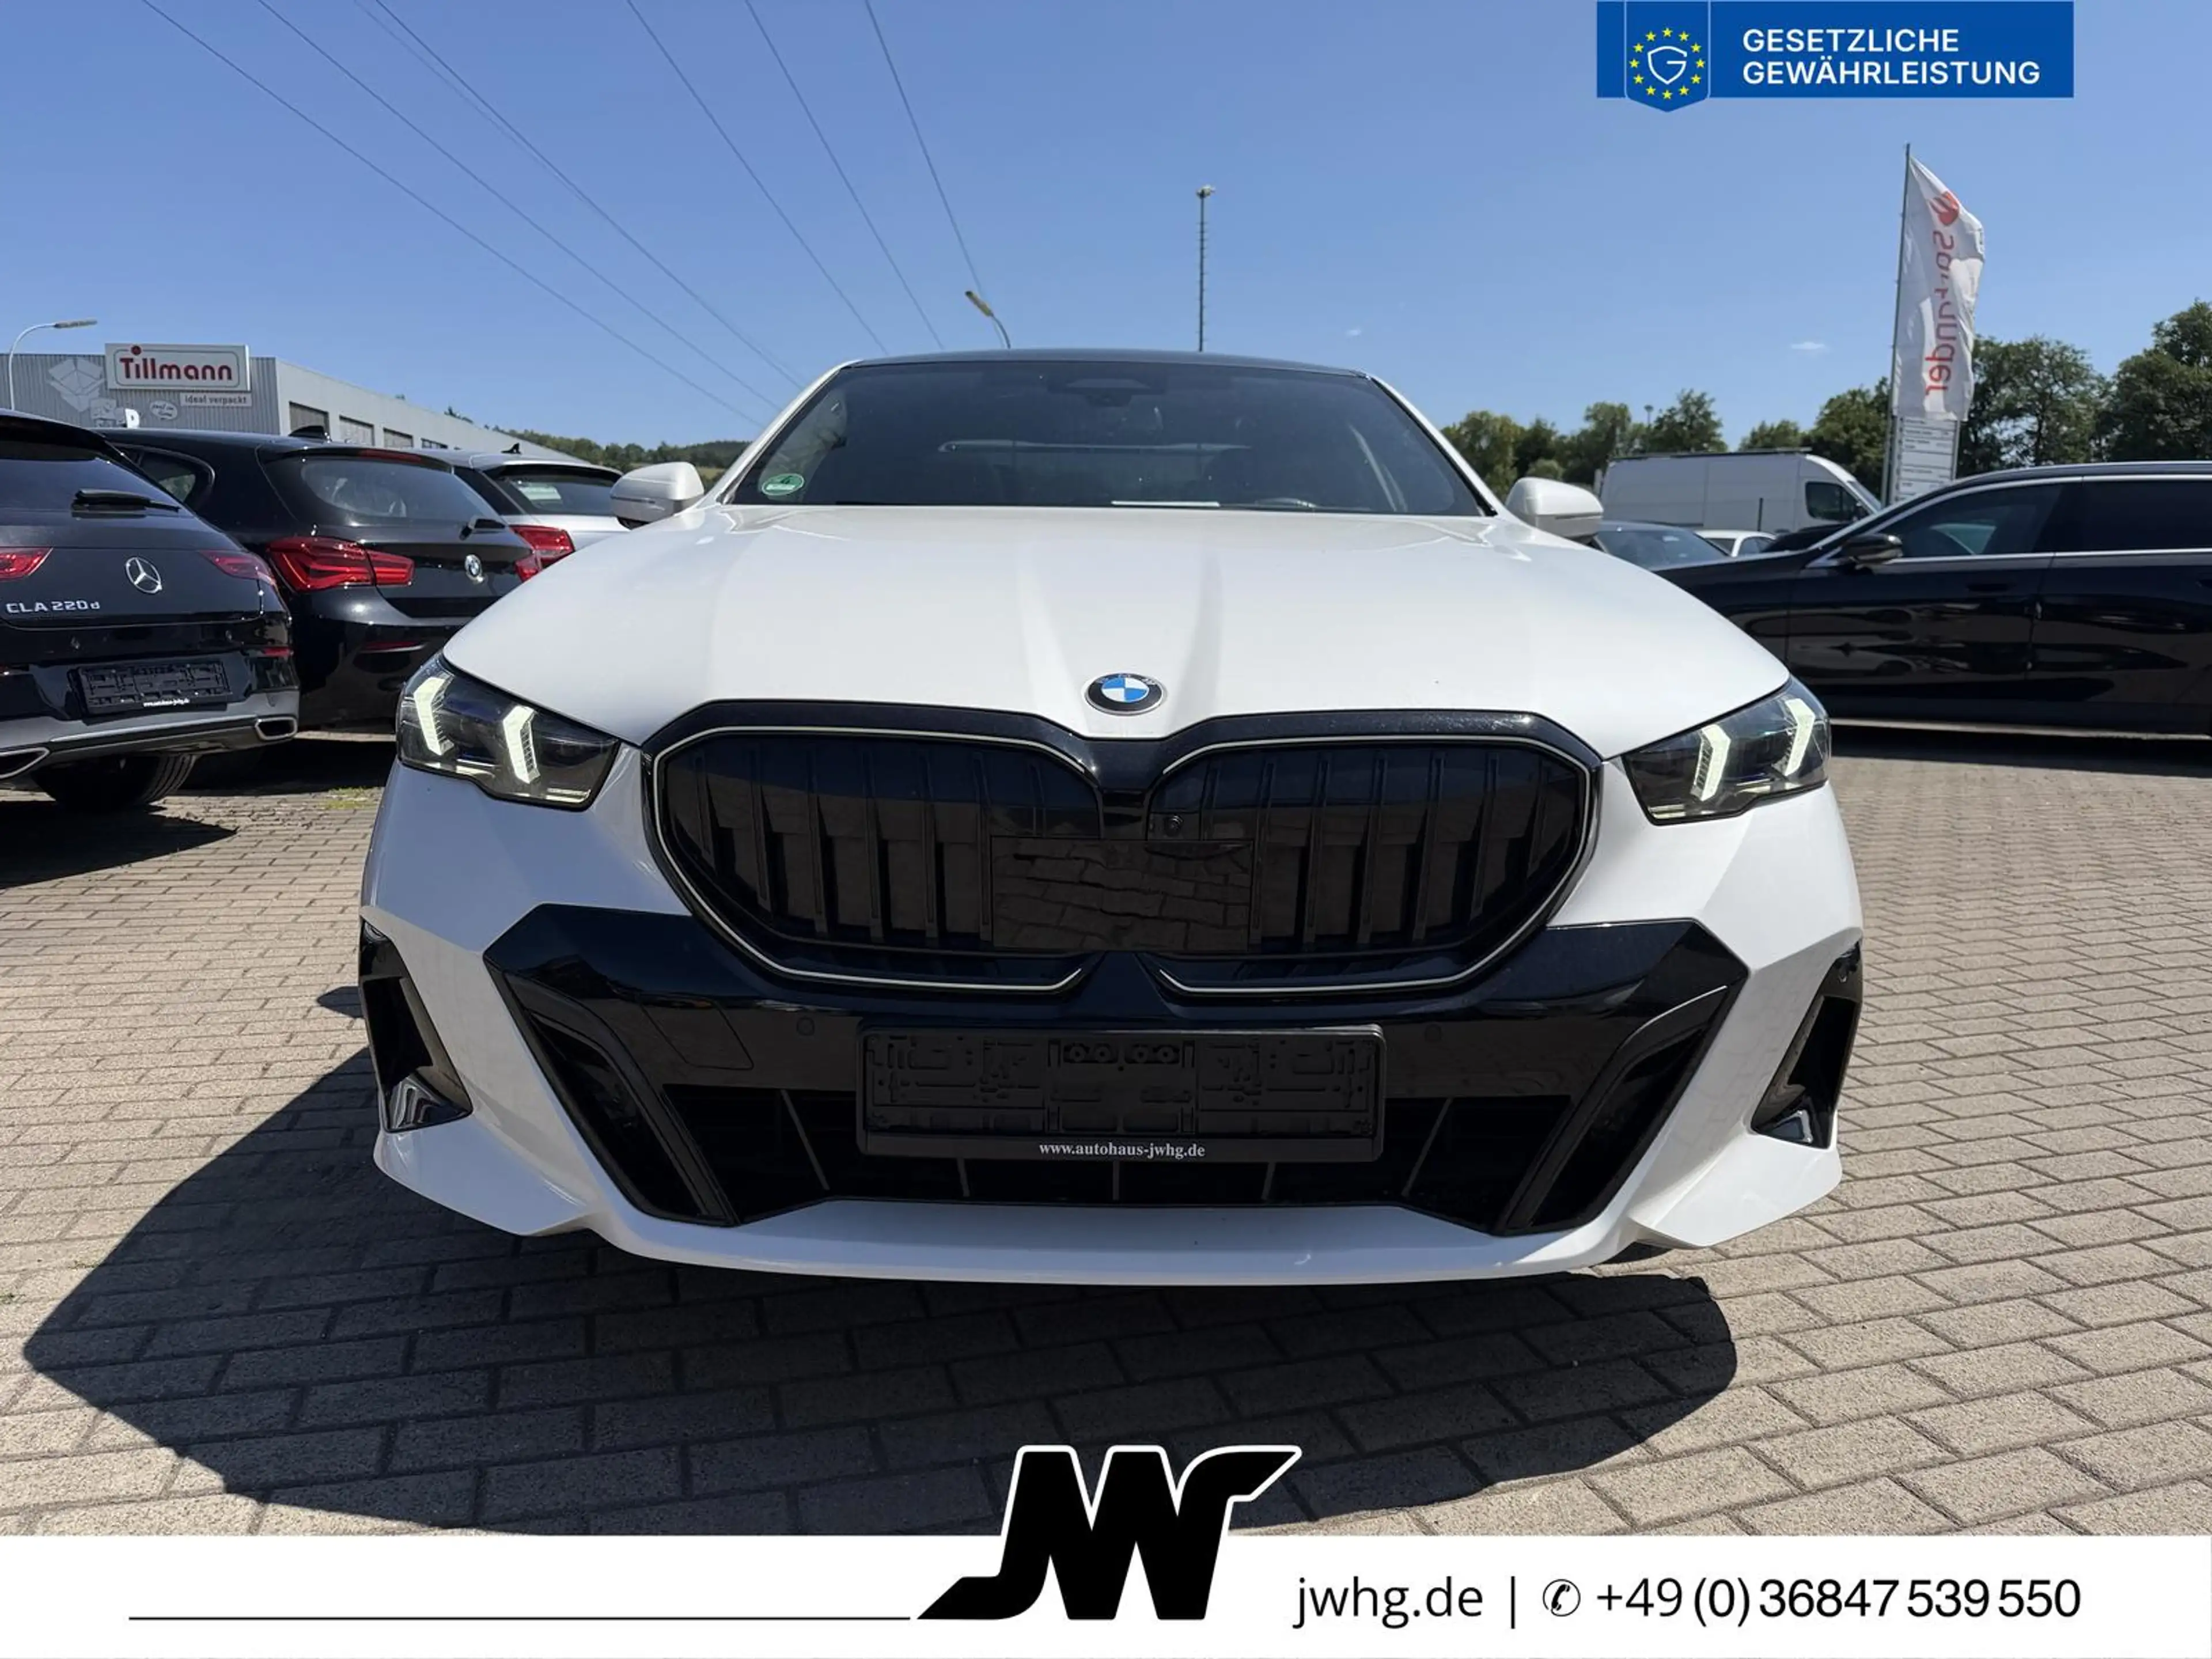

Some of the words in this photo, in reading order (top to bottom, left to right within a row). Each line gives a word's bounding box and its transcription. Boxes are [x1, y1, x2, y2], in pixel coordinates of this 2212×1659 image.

[119, 346, 233, 381] Tillmann
[184, 394, 207, 403] ideal
[6, 601, 48, 614] CLA
[1039, 1142, 1206, 1160] www.autohaus-jwhg.de
